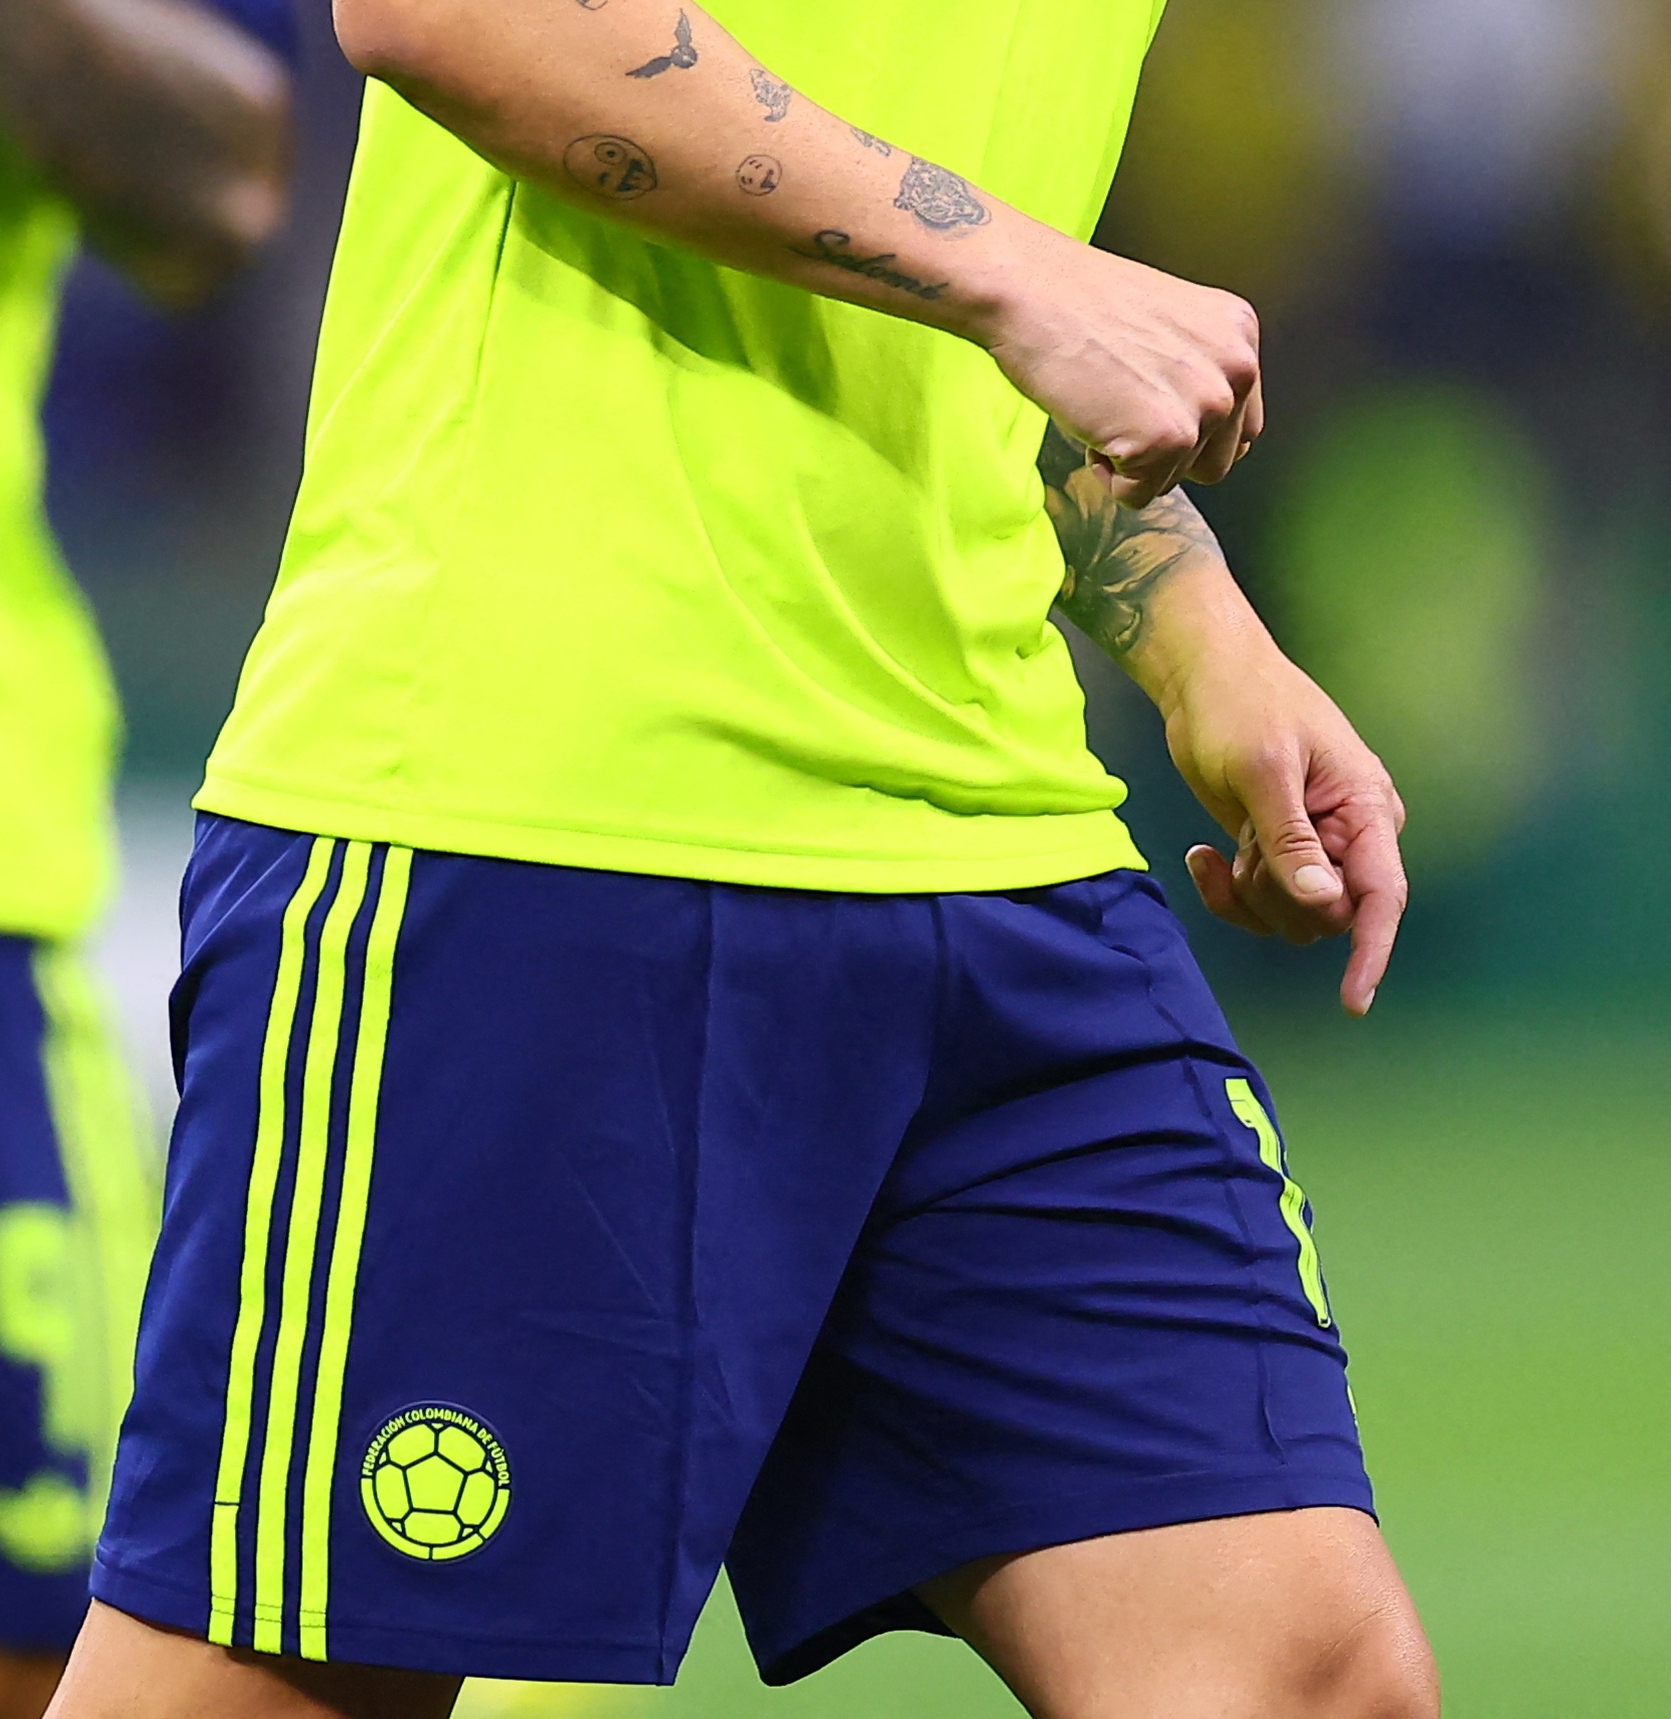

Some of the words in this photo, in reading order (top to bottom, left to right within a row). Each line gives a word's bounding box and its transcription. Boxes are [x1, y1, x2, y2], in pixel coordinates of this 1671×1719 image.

[361, 1415, 407, 1477] FEDERACIÓN
[404, 1407, 479, 1434] COLOMBIANA
[476, 1427, 493, 1445] DE
[487, 1440, 511, 1487] FÚTBOL
